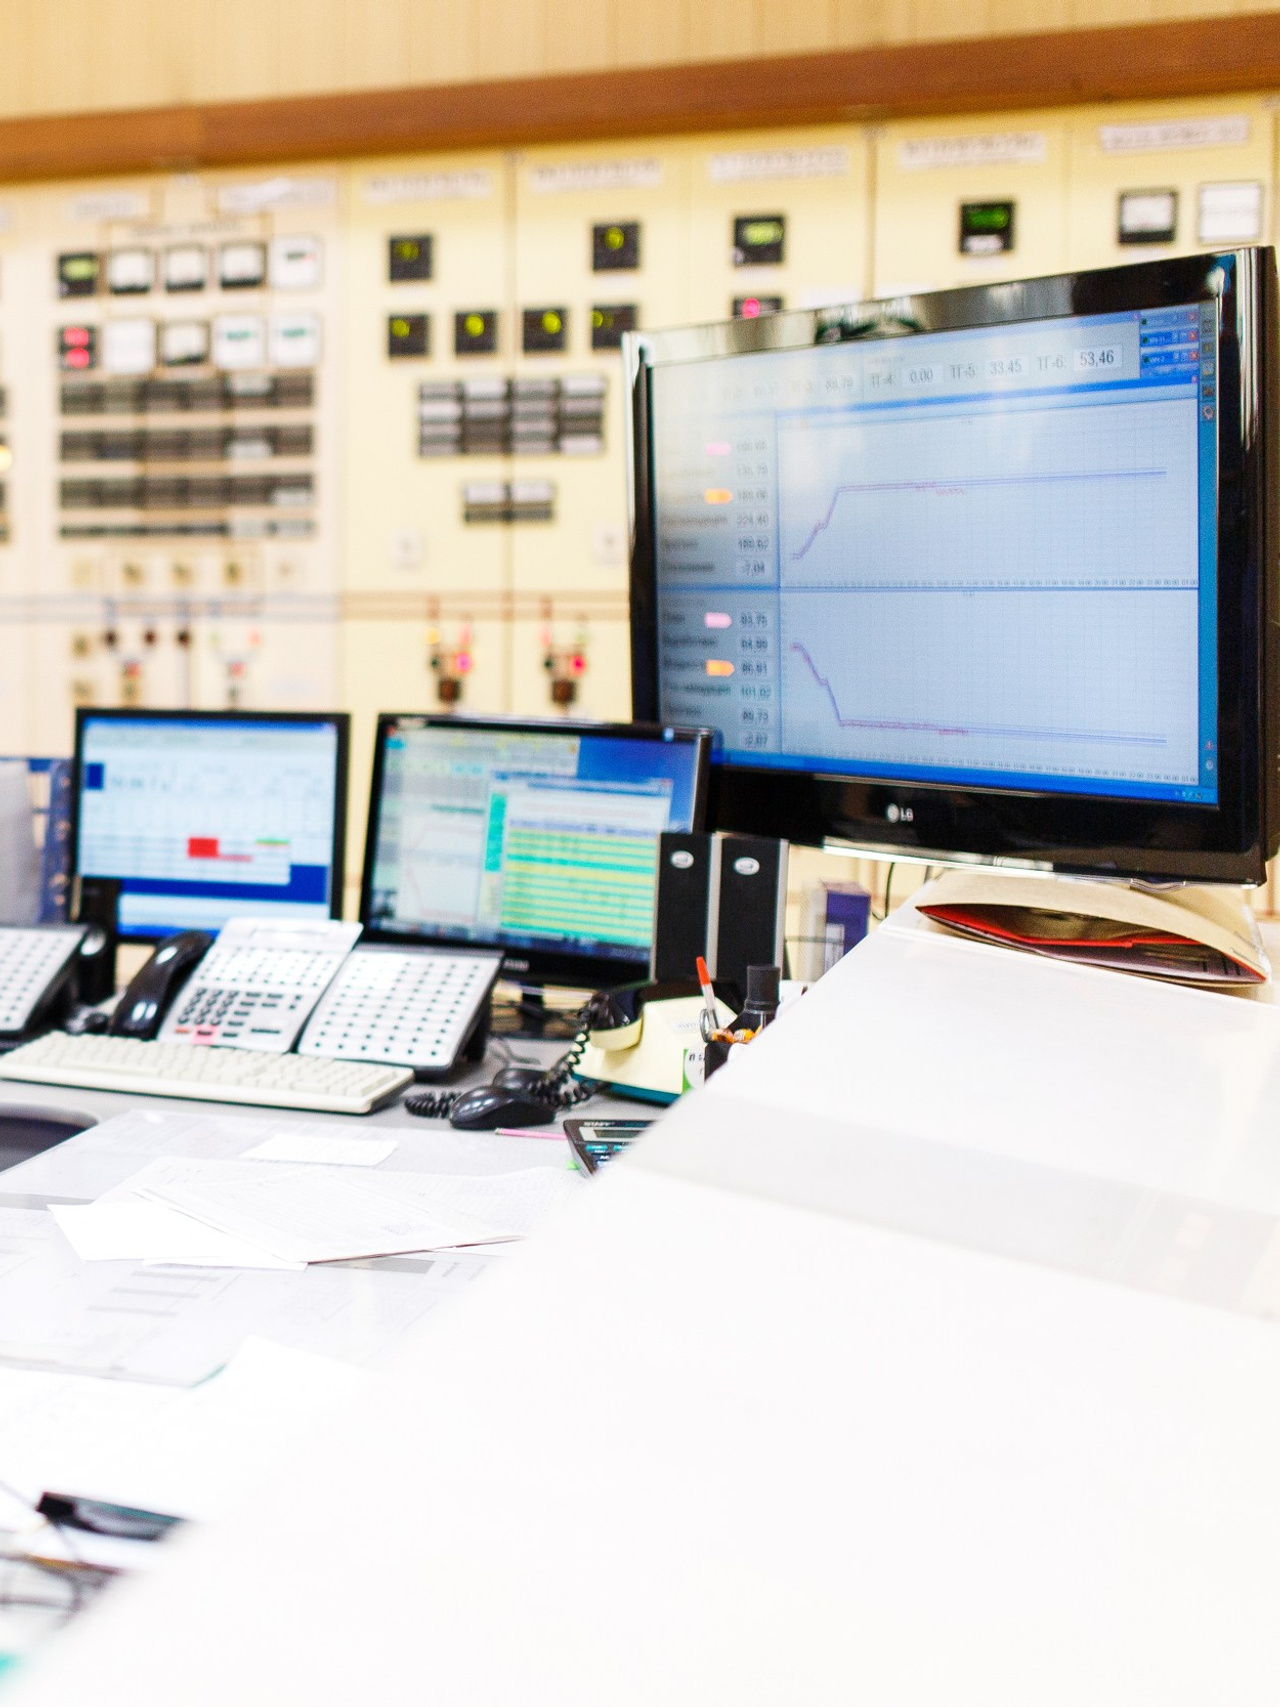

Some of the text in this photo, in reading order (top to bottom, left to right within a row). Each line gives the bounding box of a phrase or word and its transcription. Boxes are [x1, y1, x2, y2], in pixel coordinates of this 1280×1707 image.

[909, 367, 933, 384] 0,00
[990, 357, 1021, 376] 33,45
[1079, 349, 1115, 368] 53,46
